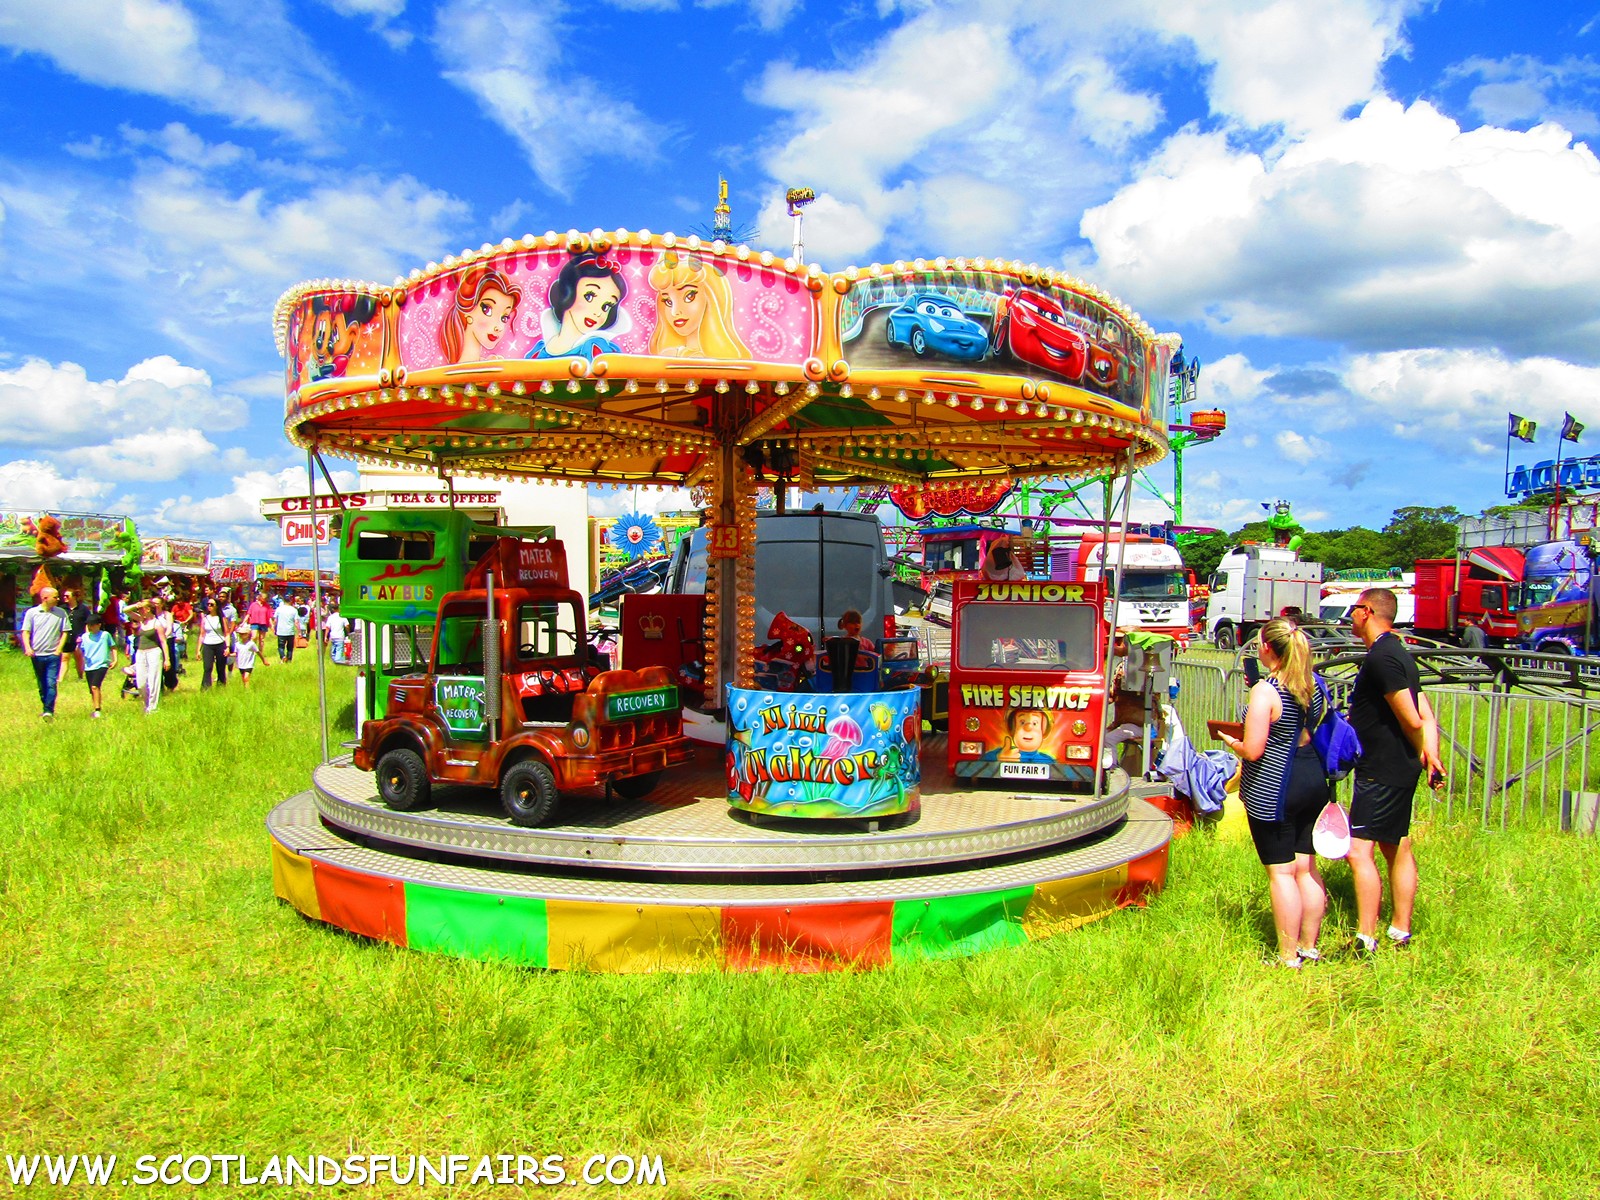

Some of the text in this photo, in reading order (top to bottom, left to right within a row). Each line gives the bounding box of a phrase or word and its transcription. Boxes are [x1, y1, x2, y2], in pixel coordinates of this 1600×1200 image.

[281, 493, 367, 511] CHIPS
[391, 493, 420, 503] TEA
[424, 493, 436, 503] &
[715, 527, 737, 548] £3
[520, 548, 553, 565] MATER
[519, 569, 559, 581] RECOVERY
[360, 585, 434, 601] PLAY BUS
[976, 584, 1085, 602] JUNIOR
[444, 685, 477, 700] MATER
[961, 684, 1092, 710] FIRE SERVICE
[617, 693, 666, 712] RECOVERY
[446, 708, 478, 720] RECOVERY
[759, 704, 828, 736] Mini
[1003, 765, 1046, 775] FUN FAIR 1
